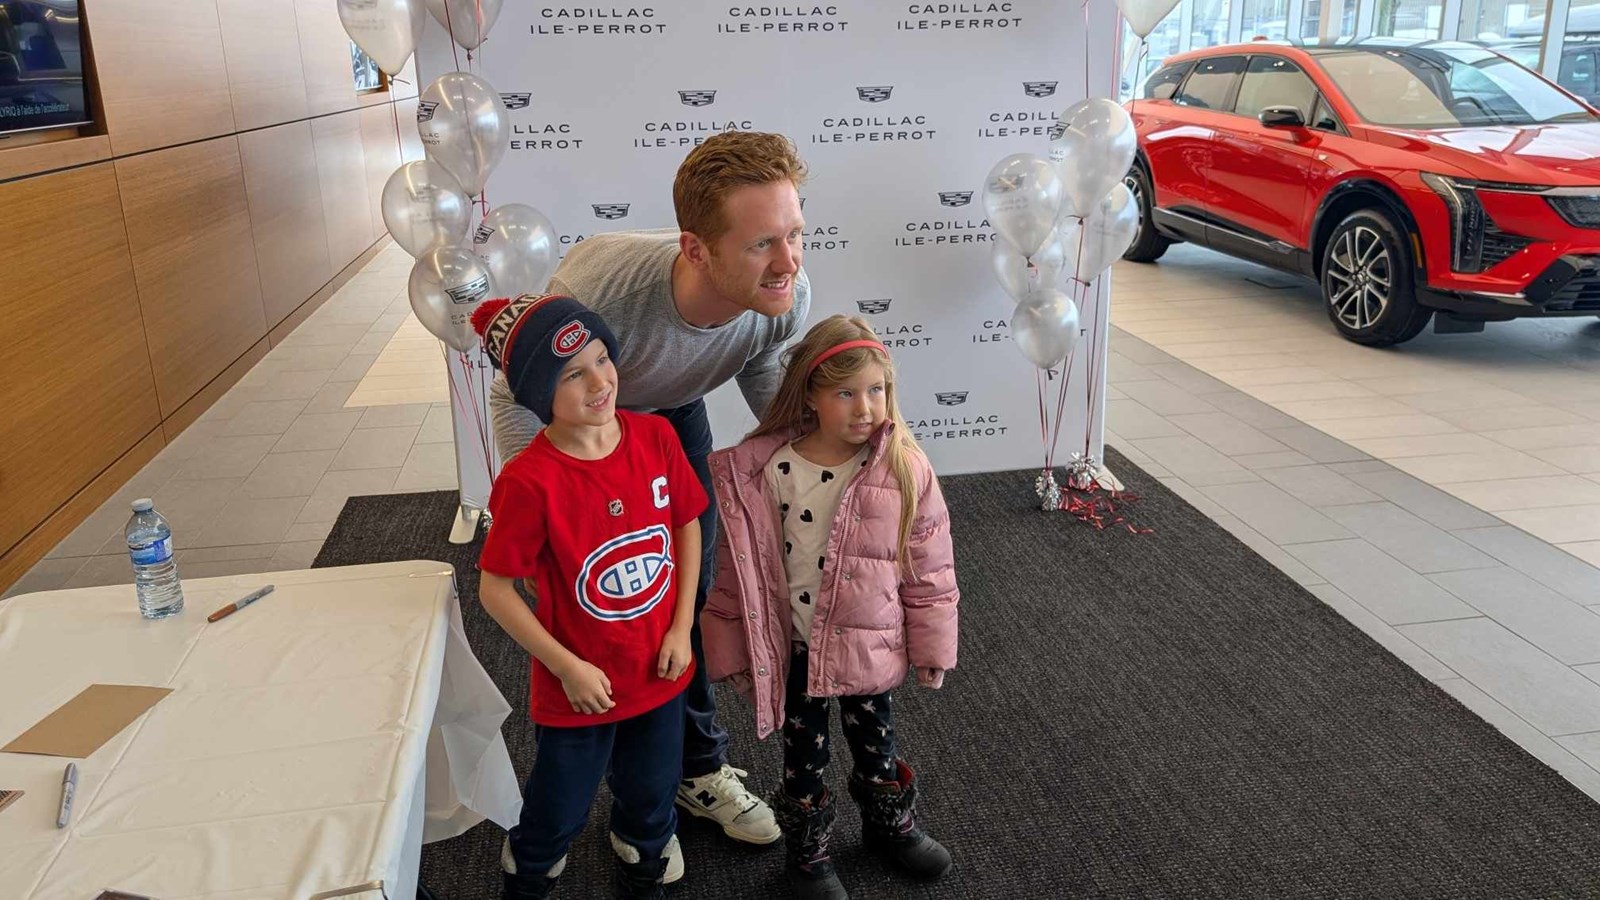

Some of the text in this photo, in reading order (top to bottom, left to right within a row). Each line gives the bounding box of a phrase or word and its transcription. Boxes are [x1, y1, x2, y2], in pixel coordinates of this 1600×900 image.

[540, 7, 654, 18] CADILLAC
[729, 6, 837, 17] CADILLAC
[908, 2, 1012, 14] CADILLAC
[530, 24, 666, 35] ILE-PERROT
[718, 22, 848, 33] ILE-PERROT
[897, 18, 1022, 30] ILE-PERROT
[823, 115, 926, 127] CADILLAC
[989, 111, 1060, 122] CADILL
[513, 124, 571, 134] LLAC
[645, 120, 752, 132] CADILLAC
[634, 137, 704, 148] ILE-PE
[812, 130, 936, 143] ILE-PERROT
[510, 139, 583, 149] ERROT
[906, 219, 991, 231] CADILLA
[895, 233, 997, 246] ILE-PERRO
[906, 415, 998, 428] CADILLAC
[914, 427, 1007, 440] E-PERROT
[651, 475, 670, 509] C
